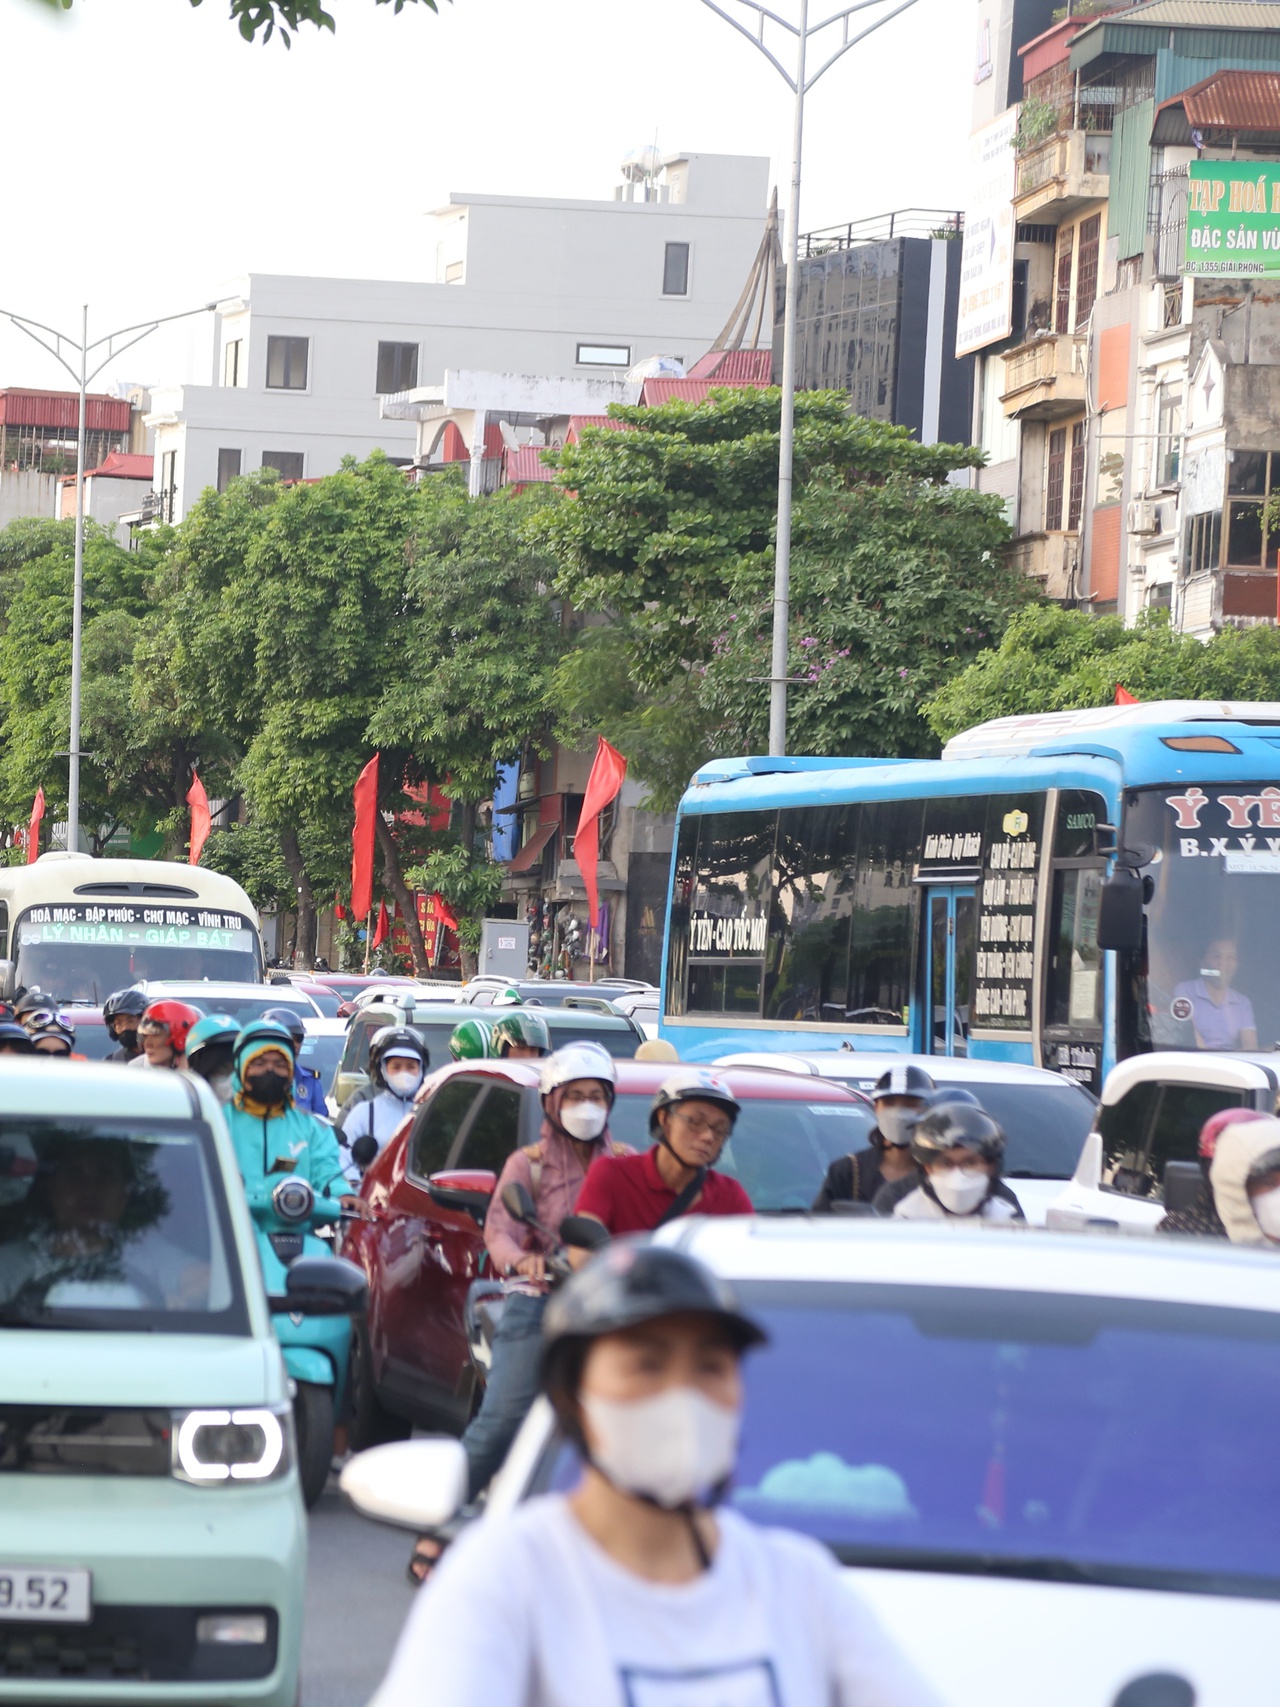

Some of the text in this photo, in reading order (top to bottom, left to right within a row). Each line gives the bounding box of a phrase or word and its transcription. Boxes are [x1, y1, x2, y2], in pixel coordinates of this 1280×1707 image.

[1189, 179, 1225, 217] TẠP
[1228, 175, 1267, 214] HOÁ
[1191, 225, 1222, 253] ĐẶC
[1226, 224, 1257, 250] SẢN
[1066, 813, 1096, 829] SAMCO
[1165, 787, 1209, 829] Ý
[30, 906, 51, 923] HOÀ
[53, 908, 77, 924] MẠC
[85, 906, 106, 925] ĐẬP
[107, 906, 135, 923] PHÚC
[143, 909, 164, 926] CHỢ
[166, 910, 189, 927] MẠC
[42, 923, 234, 947] LÝ NHÂN GIÁP BÁT
